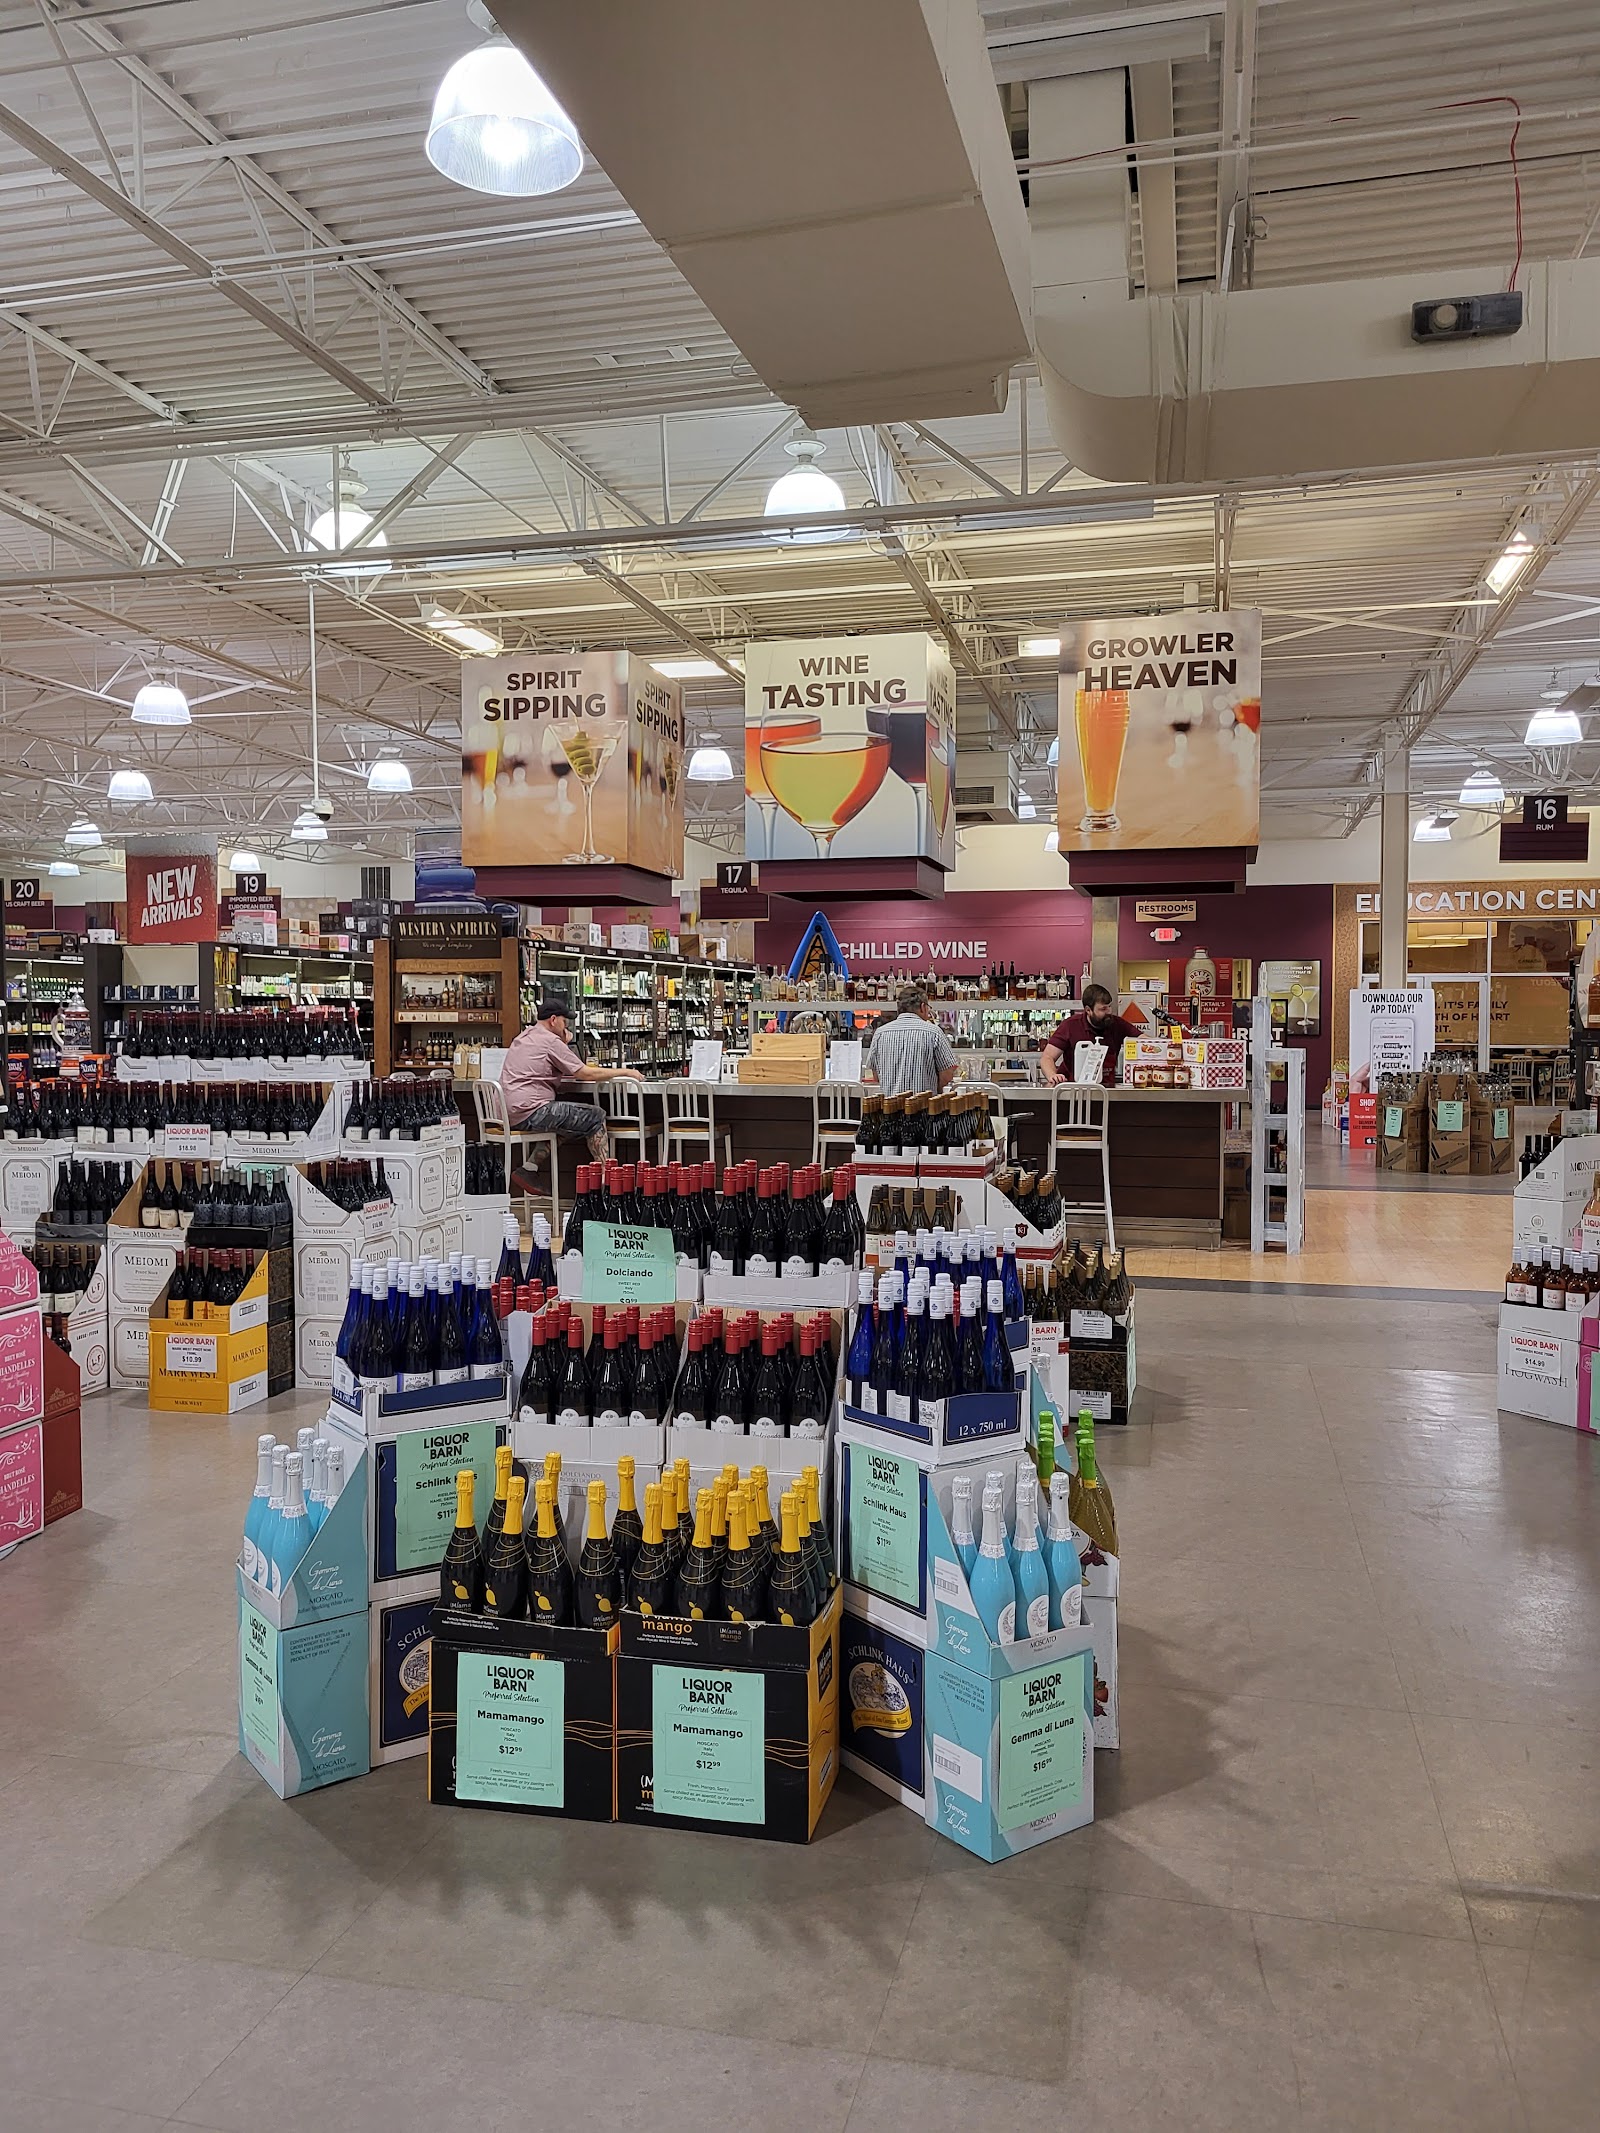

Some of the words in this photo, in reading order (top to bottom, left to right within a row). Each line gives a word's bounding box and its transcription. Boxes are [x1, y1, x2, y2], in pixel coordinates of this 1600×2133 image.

[1087, 632, 1235, 660] GROWLER
[799, 655, 869, 677] WINE
[507, 669, 582, 691] SPIRIT
[1084, 658, 1237, 692] HEAVEN
[644, 679, 672, 709] SPIRIT
[762, 679, 907, 710] TASTING
[483, 693, 607, 721] SIPPING
[636, 698, 679, 743] SIPPING
[1535, 799, 1557, 820] 16
[725, 866, 743, 884] 17
[16, 881, 35, 898] 20
[147, 865, 197, 905] NEW
[243, 876, 259, 893] 19
[1138, 903, 1195, 913] RESTROOMS
[1356, 891, 1525, 913] ECATION
[1536, 888, 1600, 910] CEN
[140, 896, 203, 928] ARRIVALS
[399, 921, 446, 936] WESTERN
[450, 921, 497, 936] SPIRITS
[839, 941, 923, 959] CHILLED
[928, 941, 988, 958] WINE
[1362, 993, 1405, 1003] DOWNLOAD
[1407, 993, 1423, 1003] OUR
[1444, 1001, 1464, 1009] IT'S
[1467, 1001, 1508, 1009] FAILY
[1370, 1004, 1387, 1014] APP
[1388, 1004, 1415, 1014] TODAY!
[1452, 1013, 1468, 1021] OF
[1471, 1013, 1511, 1021] HART
[1359, 1099, 1376, 1107] SHOP
[133, 1230, 160, 1238] MEIOMI
[608, 1228, 649, 1241] LIQUOR
[614, 1239, 644, 1250] BARN
[124, 1255, 169, 1267] MEIOMI
[308, 1257, 340, 1265] MEIOMI
[366, 1248, 392, 1263] MEIOMI
[604, 1250, 631, 1259] Preferred
[632, 1251, 655, 1259] Selection
[606, 1268, 653, 1277] Dolciando
[1035, 1326, 1057, 1335] BARN
[167, 1336, 195, 1345] LIQUOR
[195, 1338, 215, 1346] BARN
[1511, 1336, 1538, 1348] LIQUOR
[1539, 1341, 1559, 1352] BARN
[232, 1351, 249, 1363] MARK
[958, 1425, 969, 1436] 12
[979, 1421, 994, 1432] 750
[996, 1418, 1007, 1429] ml
[423, 1432, 470, 1449] LIQUOR
[430, 1445, 462, 1460] BARN
[419, 1459, 448, 1471] Preferred
[449, 1456, 474, 1467] Selection
[867, 1454, 900, 1476] LIQUOR
[415, 1476, 451, 1490] Schlink
[872, 1469, 896, 1486] BARN
[863, 1496, 888, 1512] Schlink
[889, 1505, 907, 1519] Haus
[308, 1560, 340, 1584] Gemma
[320, 1571, 343, 1590] Luna
[309, 1591, 344, 1604] MOSCATO
[642, 1620, 693, 1635] mango
[944, 1616, 969, 1637] Gemma
[953, 1637, 971, 1654] Luna
[1029, 1635, 1057, 1649] MOSCATO
[487, 1665, 535, 1681] LIQUOR
[848, 1645, 884, 1662] SCHLINK
[885, 1655, 910, 1684] HAUS
[493, 1678, 527, 1692] BARN
[682, 1677, 733, 1693] LIQUOR
[1023, 1672, 1062, 1695] LIQUOR
[482, 1690, 512, 1701] Preferred
[513, 1693, 539, 1703] Selection
[689, 1691, 725, 1705] BARN
[1028, 1687, 1056, 1707] BARN
[477, 1709, 545, 1726] Mamamango
[678, 1703, 709, 1714] Preferred
[710, 1706, 738, 1716] Selection
[1020, 1706, 1044, 1720] Preferred
[1044, 1700, 1065, 1714] Selection
[673, 1723, 743, 1739] Mamamango
[1011, 1727, 1043, 1745] Gemma
[1044, 1722, 1053, 1734] di
[1054, 1716, 1074, 1731] Luna
[310, 1727, 343, 1752] Gemma
[323, 1737, 347, 1758] Luna
[312, 1756, 347, 1771] MOSCATO
[944, 1794, 968, 1817] Gemma
[953, 1818, 970, 1835] Luna
[1029, 1812, 1057, 1829] MOSCATO
